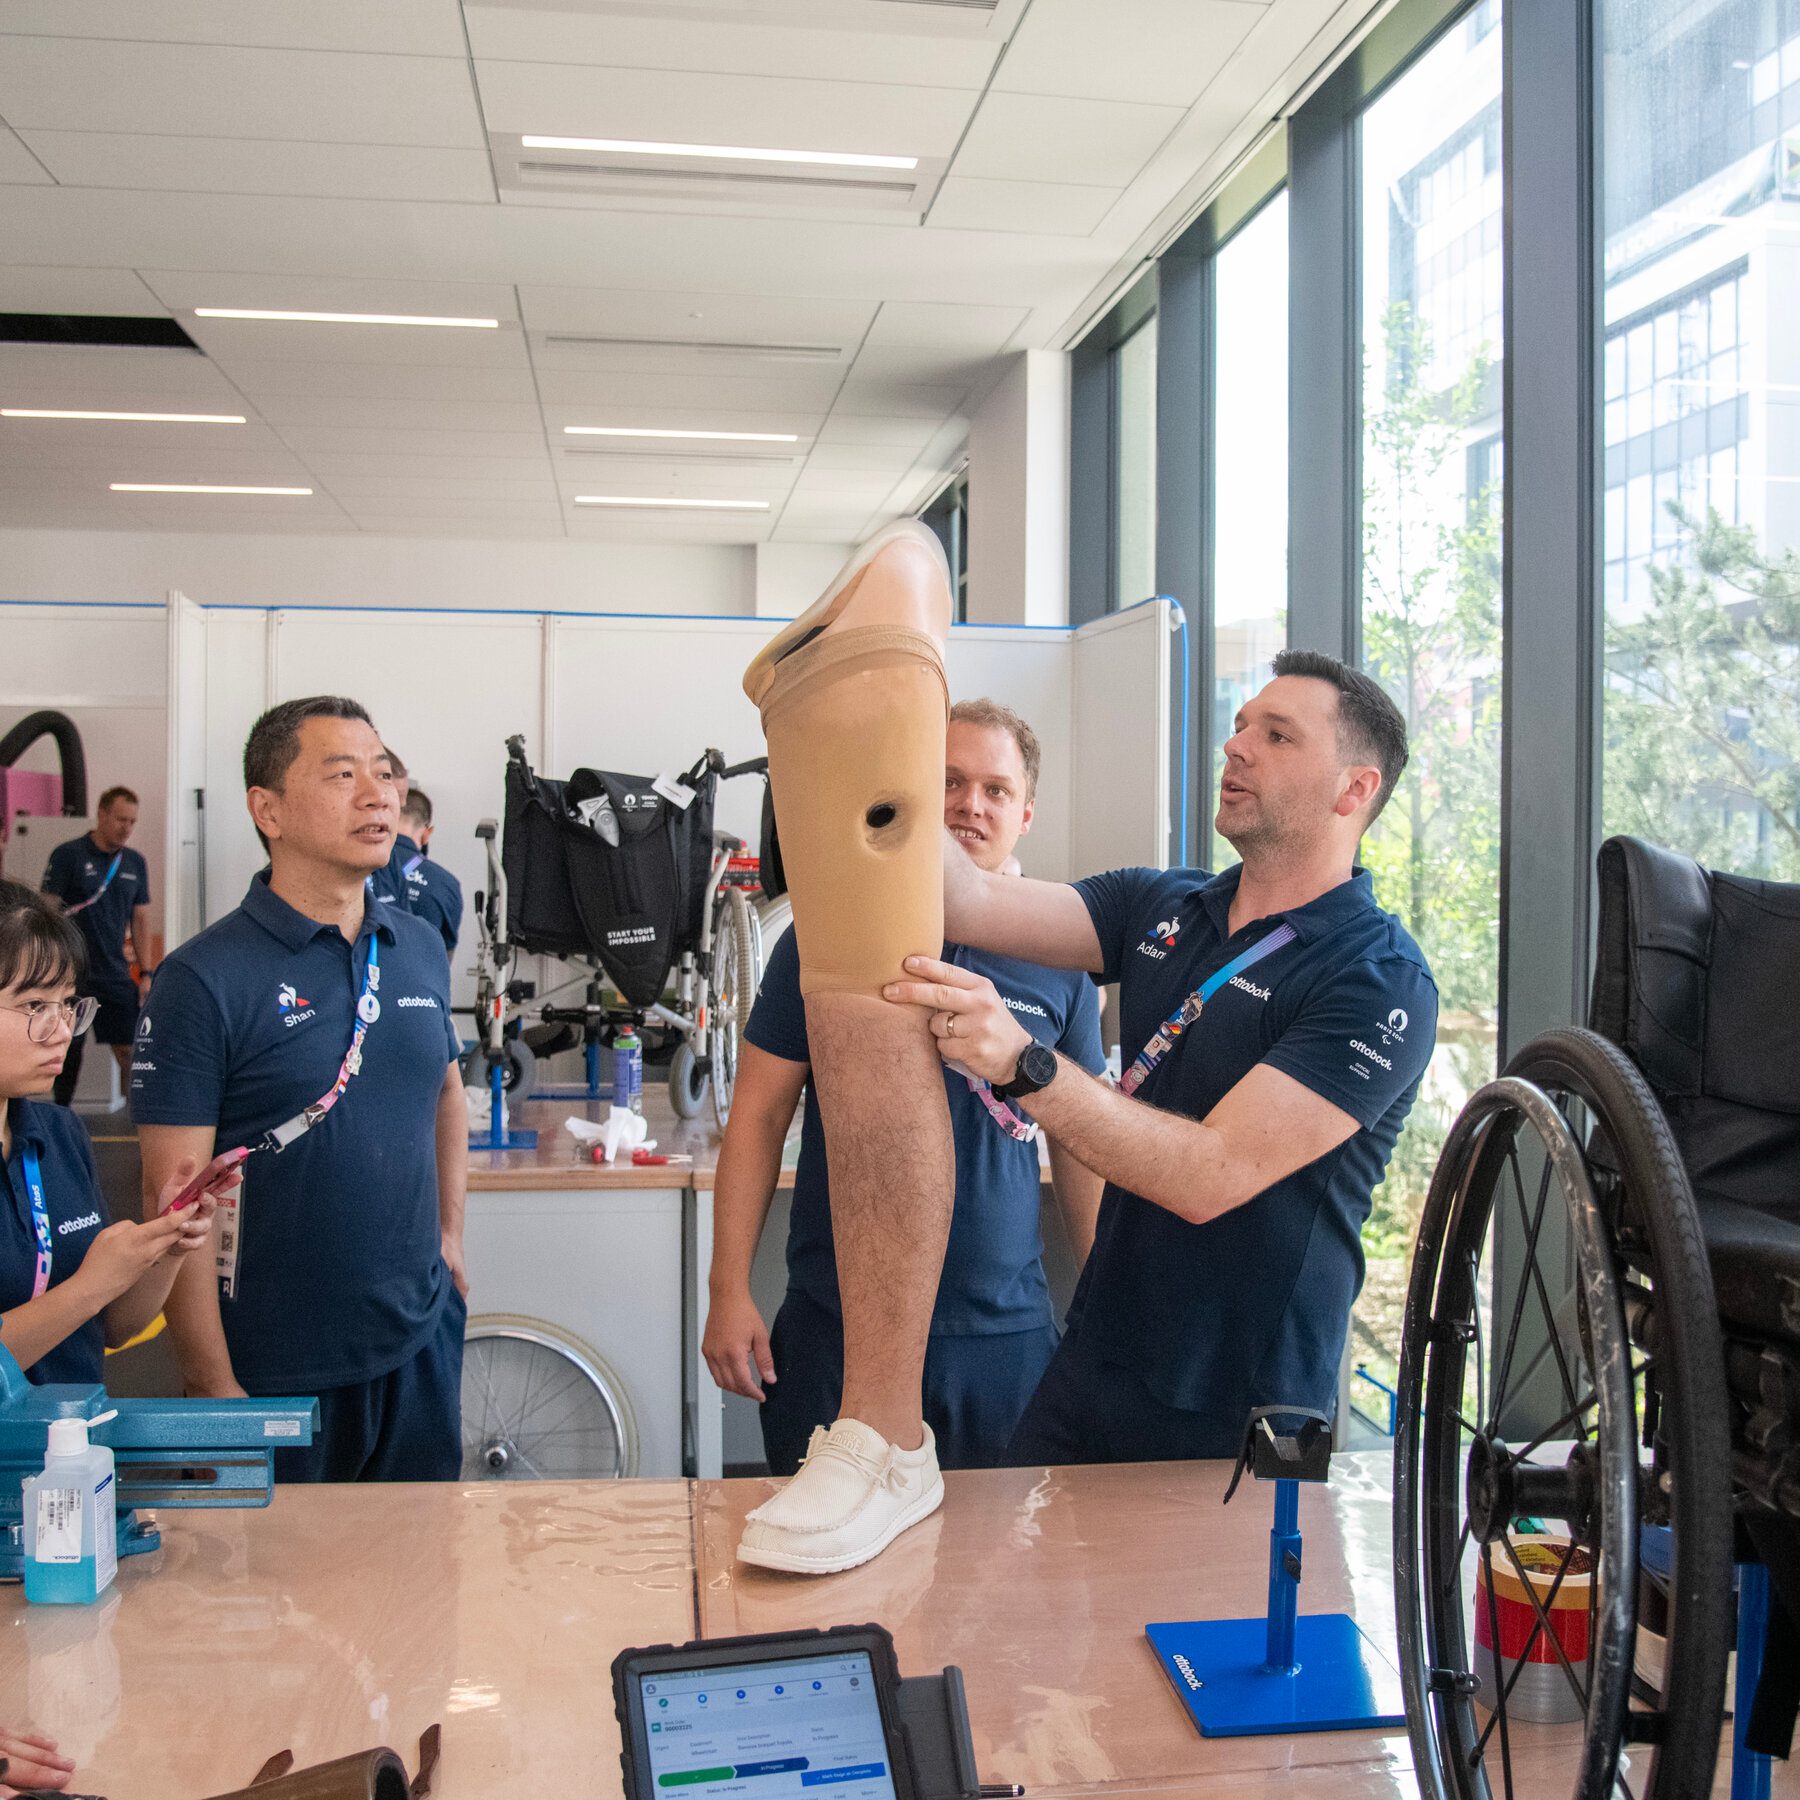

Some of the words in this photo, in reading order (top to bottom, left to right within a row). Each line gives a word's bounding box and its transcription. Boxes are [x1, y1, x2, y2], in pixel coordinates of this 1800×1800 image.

[607, 930, 631, 939] START
[632, 926, 655, 936] YOUR
[608, 933, 656, 946] IMPOSSIBLE
[1002, 996, 1047, 1018] ttobock.
[284, 1008, 316, 1027] Shan
[1376, 1022, 1392, 1035] PARIS
[1349, 1039, 1392, 1071] ottobock.
[1172, 1654, 1203, 1690] ottobock.
